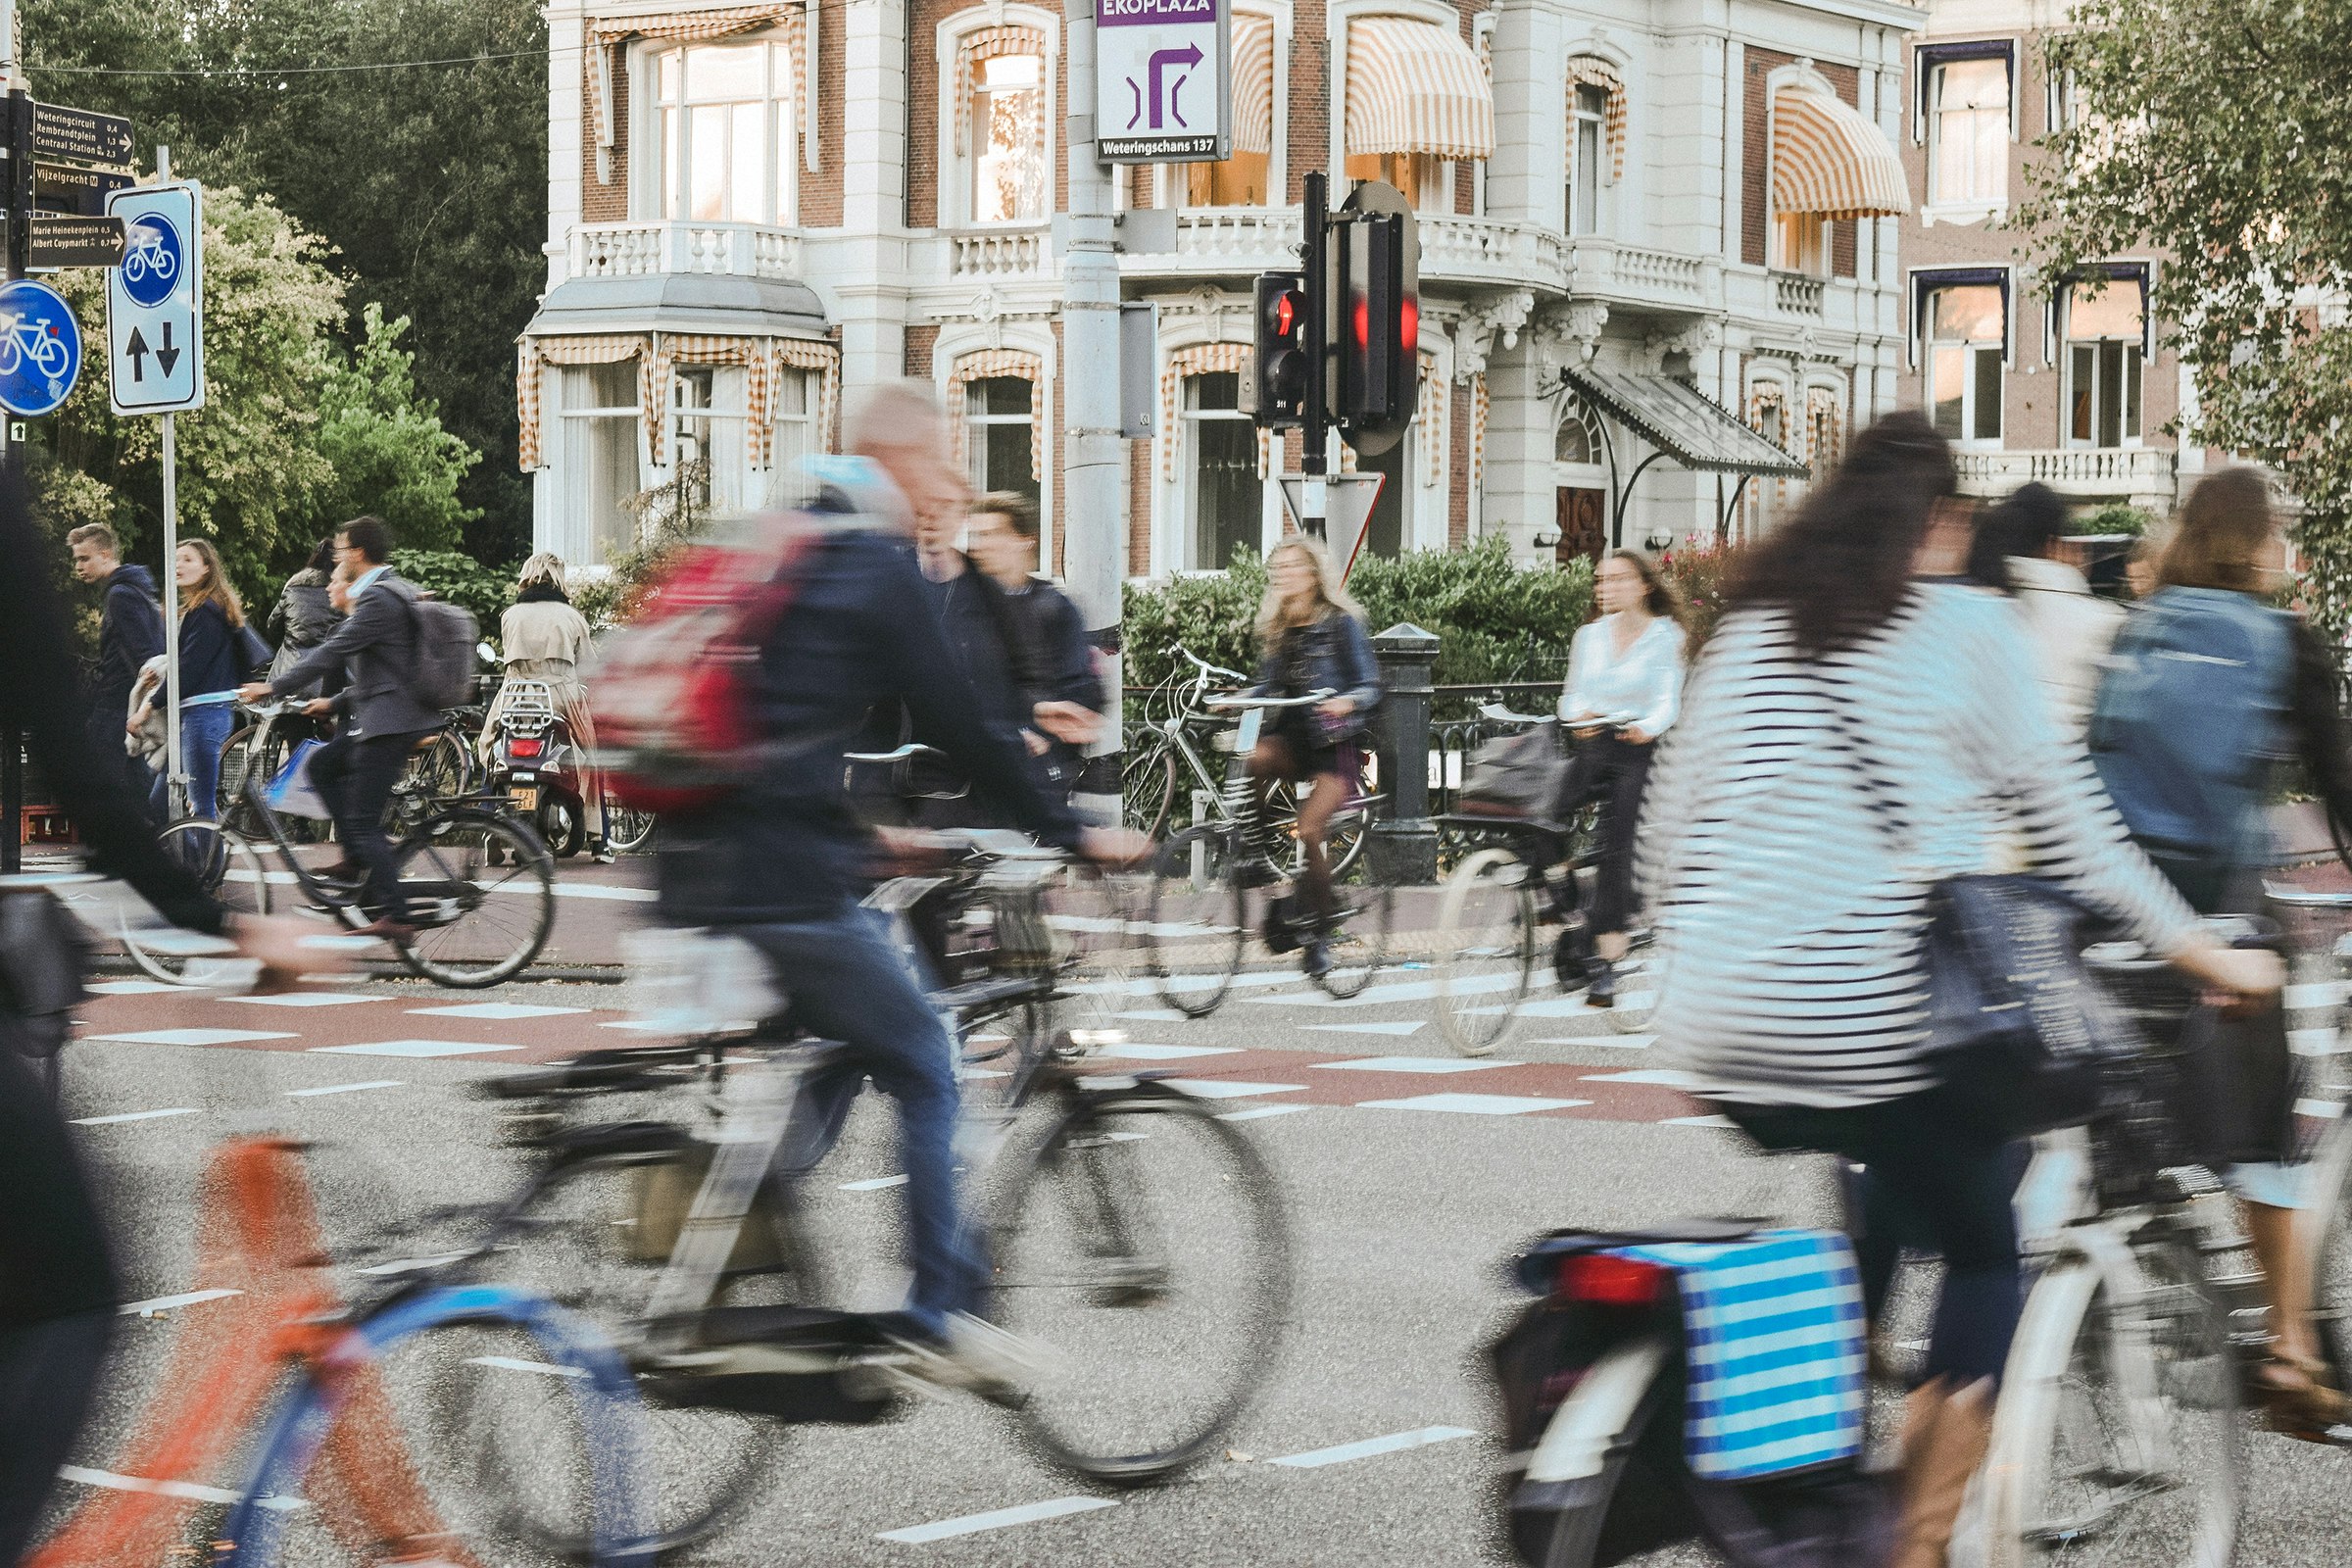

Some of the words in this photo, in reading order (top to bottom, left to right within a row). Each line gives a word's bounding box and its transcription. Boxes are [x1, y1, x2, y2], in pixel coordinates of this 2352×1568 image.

[1102, 0, 1210, 16] EKOPLAZA
[36, 110, 96, 129] Weteringcircuit
[106, 124, 118, 133] 0,4
[36, 123, 96, 142] Rembrandtplein
[36, 136, 68, 150] Centraal
[69, 141, 96, 155] Station
[1102, 139, 1191, 156] Weteringschans
[1193, 138, 1214, 152] 137
[36, 169, 88, 185] Vijzelgracht
[109, 180, 122, 189] 0,4
[32, 225, 52, 235] Marie
[52, 225, 99, 235] Heinekenplein
[32, 239, 53, 248] Albert
[53, 239, 88, 249] Cuypmarkt
